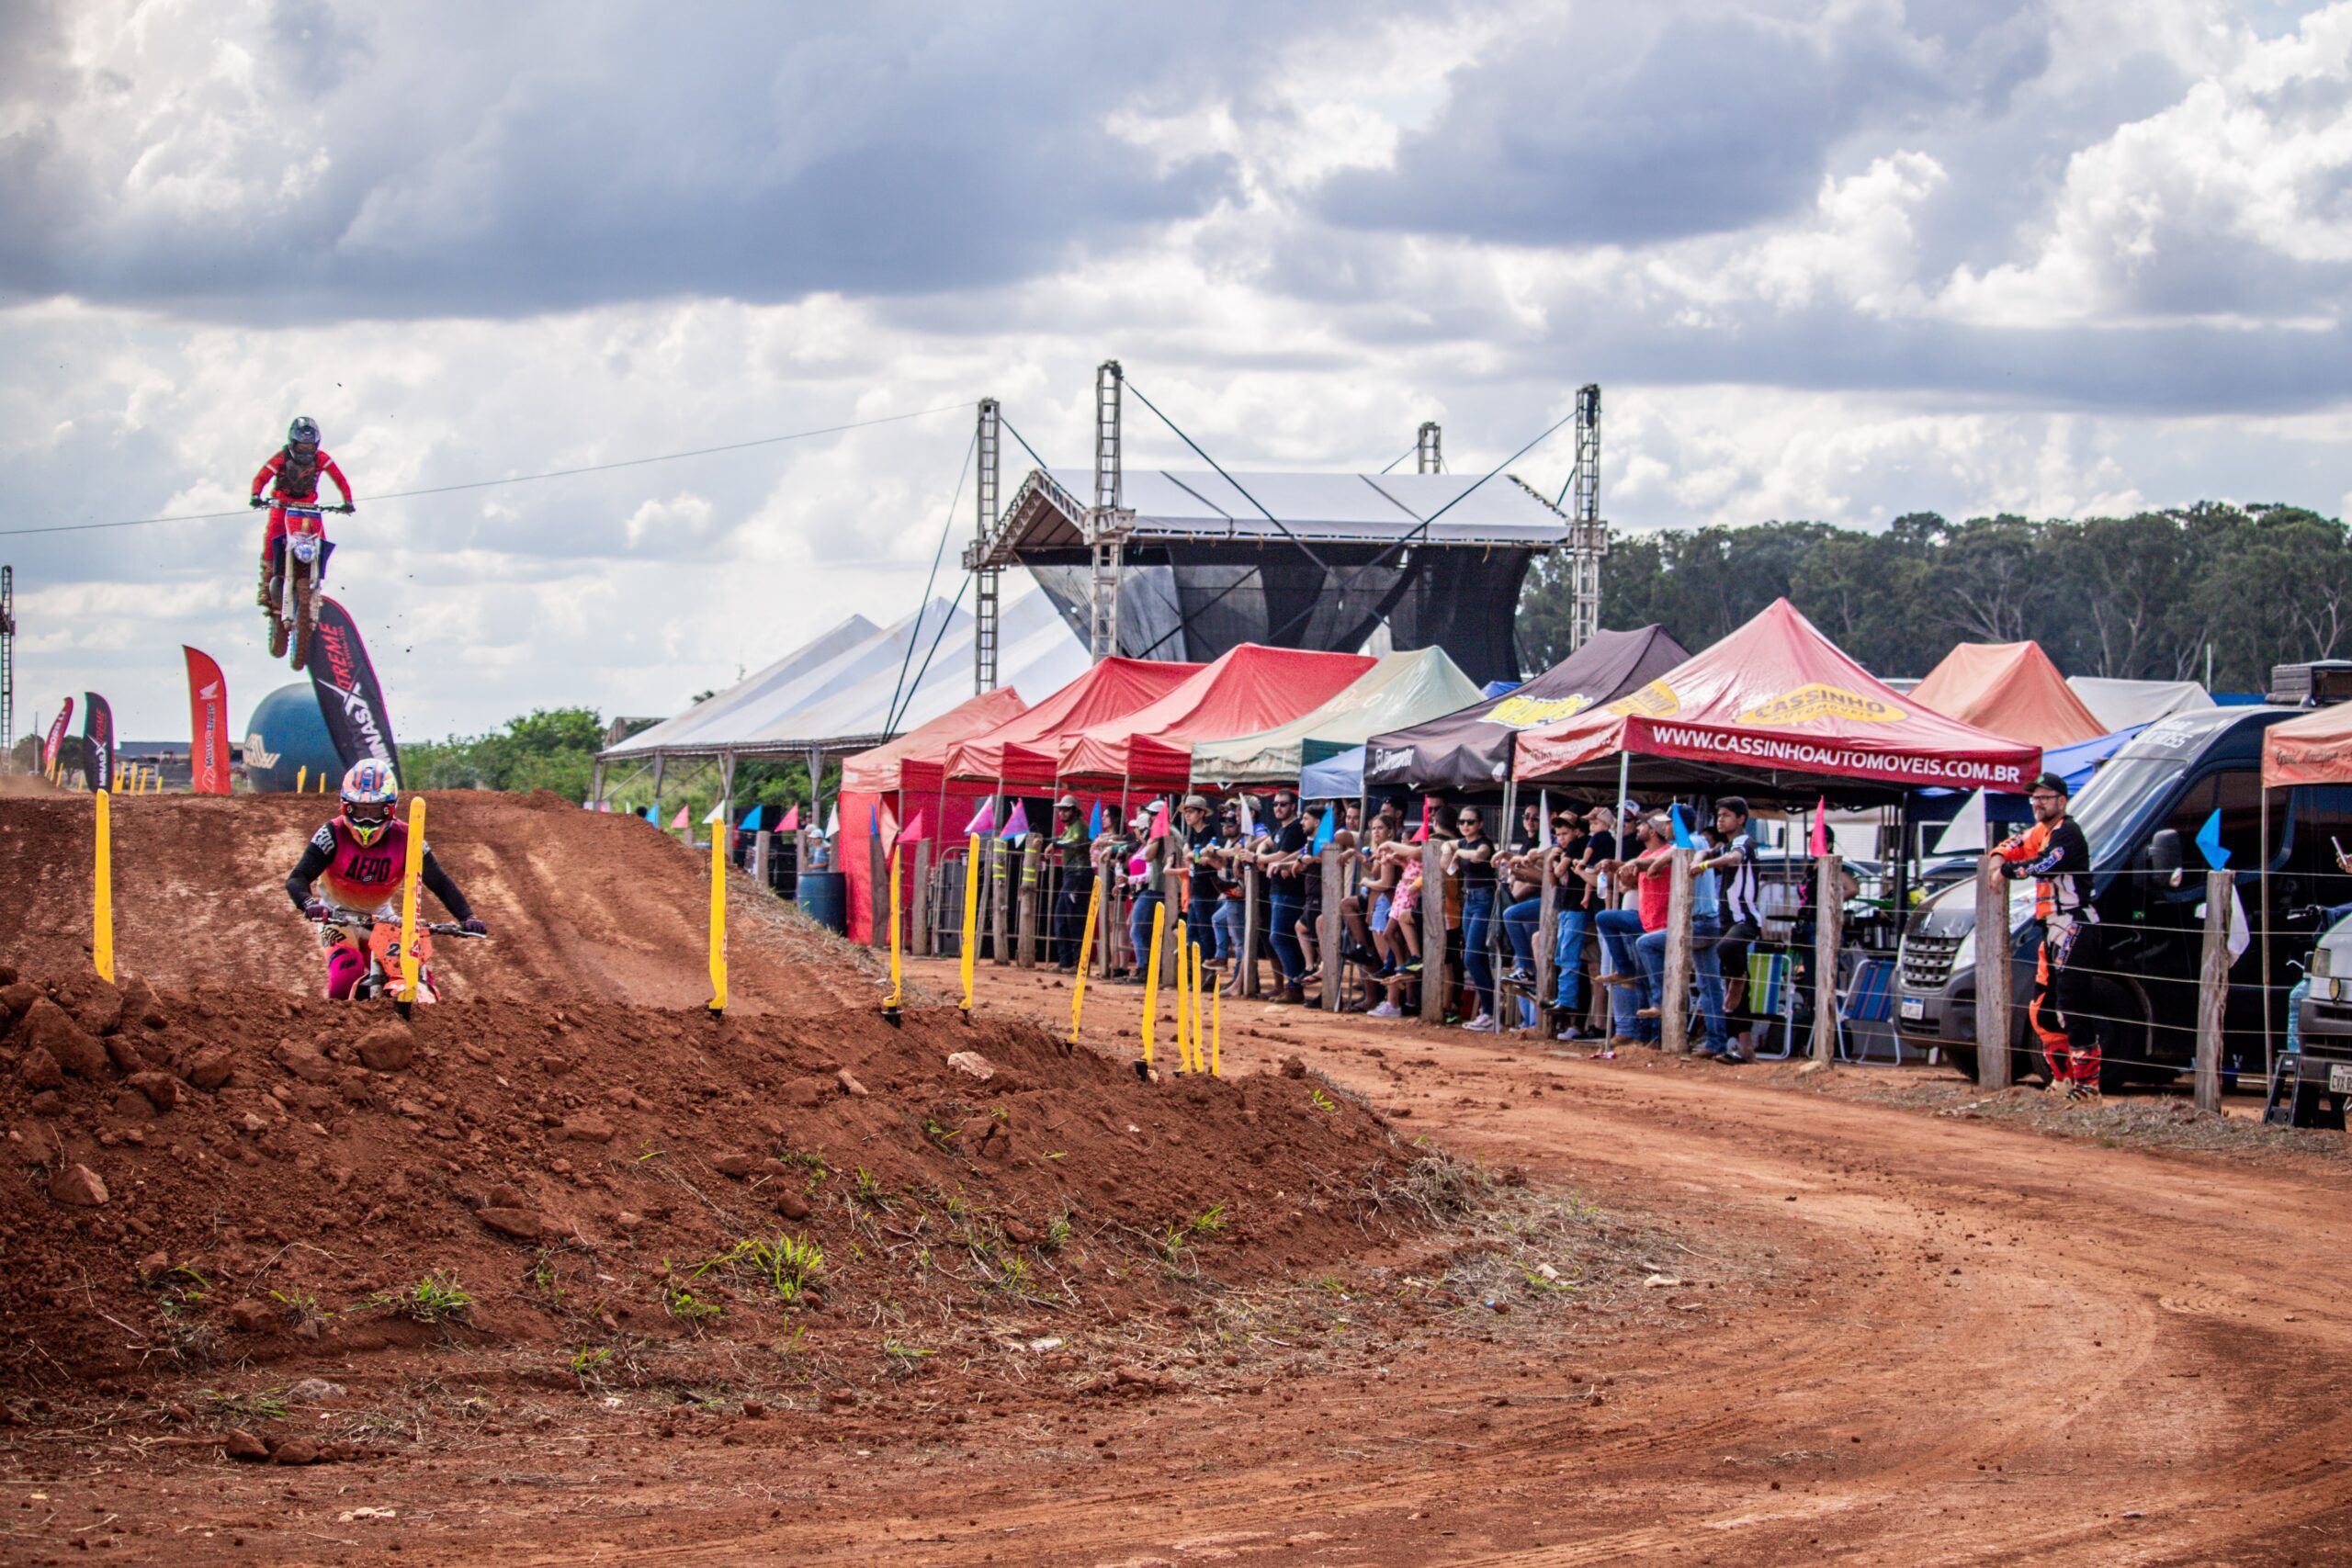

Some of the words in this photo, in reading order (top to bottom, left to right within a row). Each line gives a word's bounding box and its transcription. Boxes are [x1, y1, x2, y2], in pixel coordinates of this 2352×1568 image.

[1755, 689, 1886, 718] CASSINHO
[1653, 726, 2020, 783] WWW.CASSINHOAUTOMOVEIS.COM.BR
[345, 854, 391, 883] AERO
